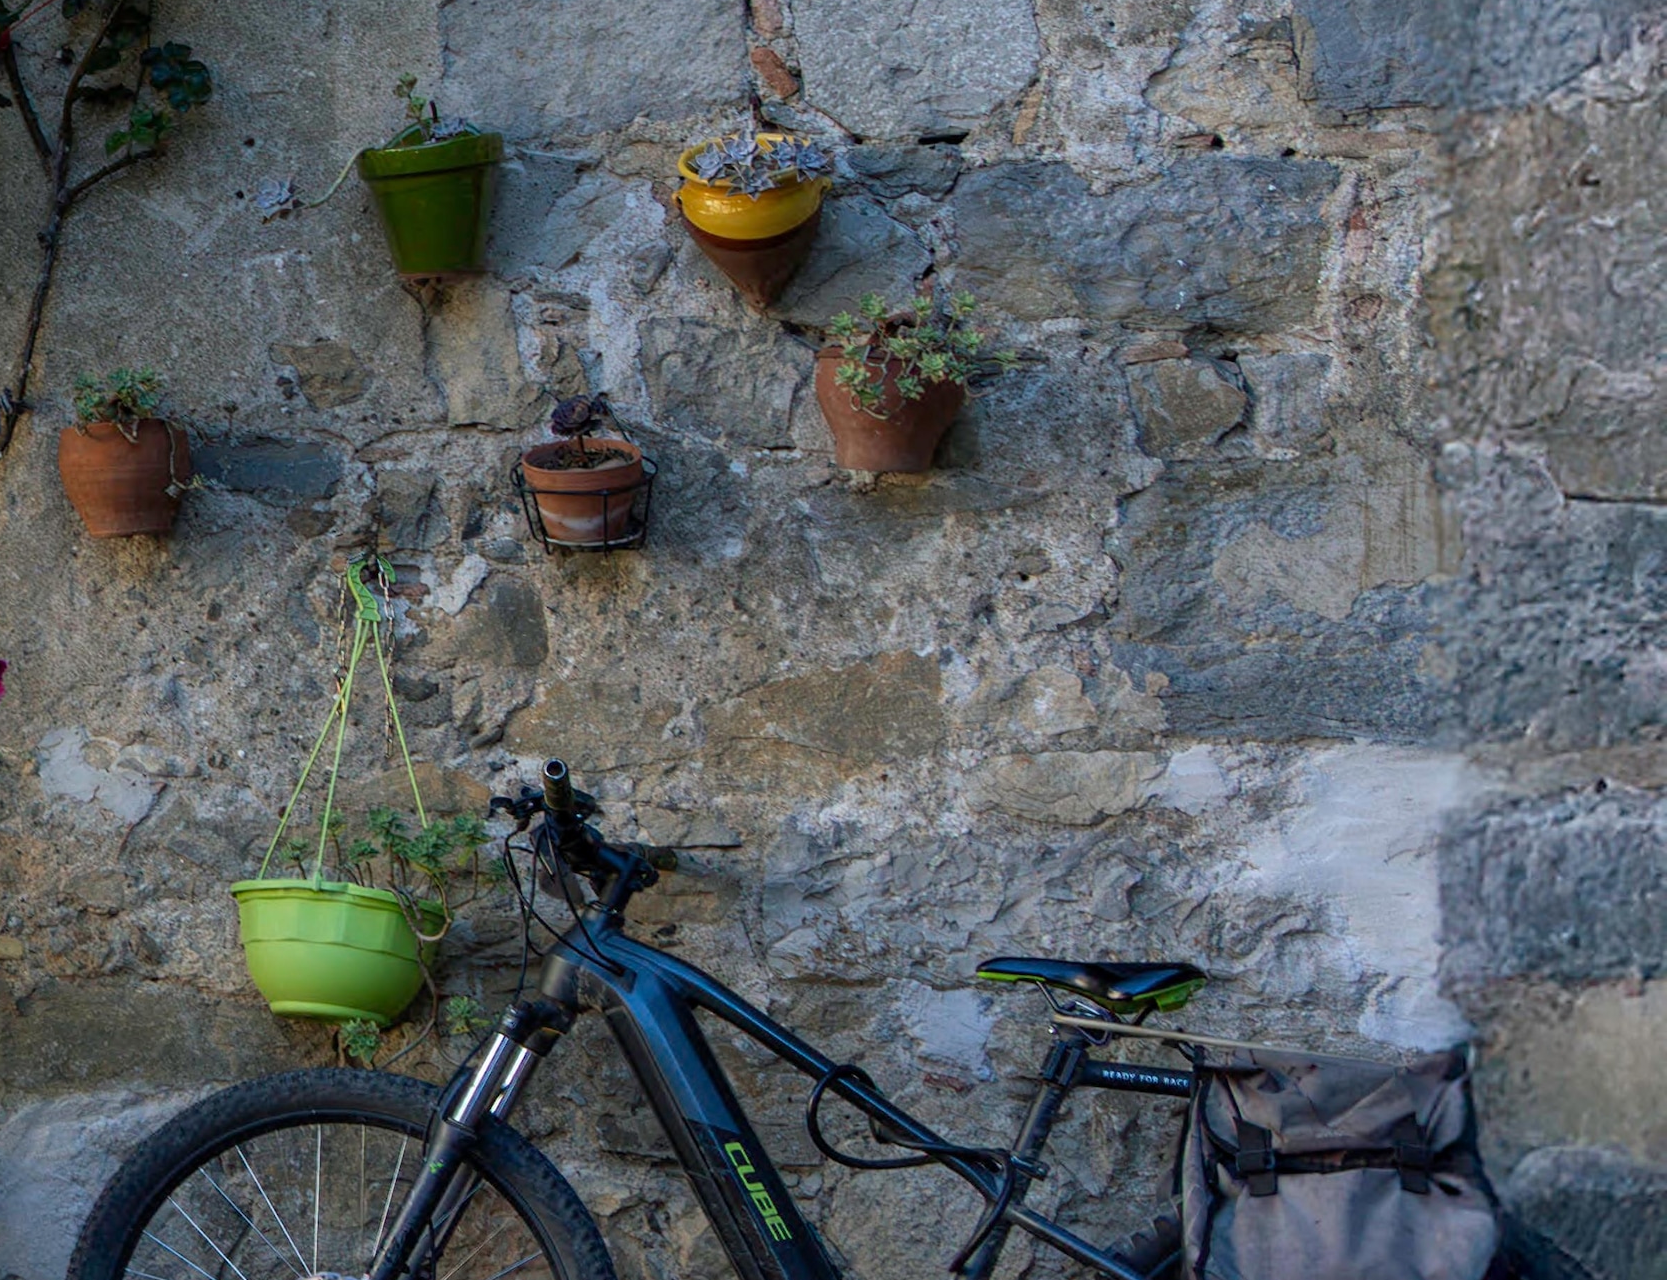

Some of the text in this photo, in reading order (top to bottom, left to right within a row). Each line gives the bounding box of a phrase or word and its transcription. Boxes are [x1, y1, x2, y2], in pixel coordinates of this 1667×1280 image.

[1102, 1069, 1189, 1088] READY FOR RACE
[724, 1142, 793, 1242] CUBE
